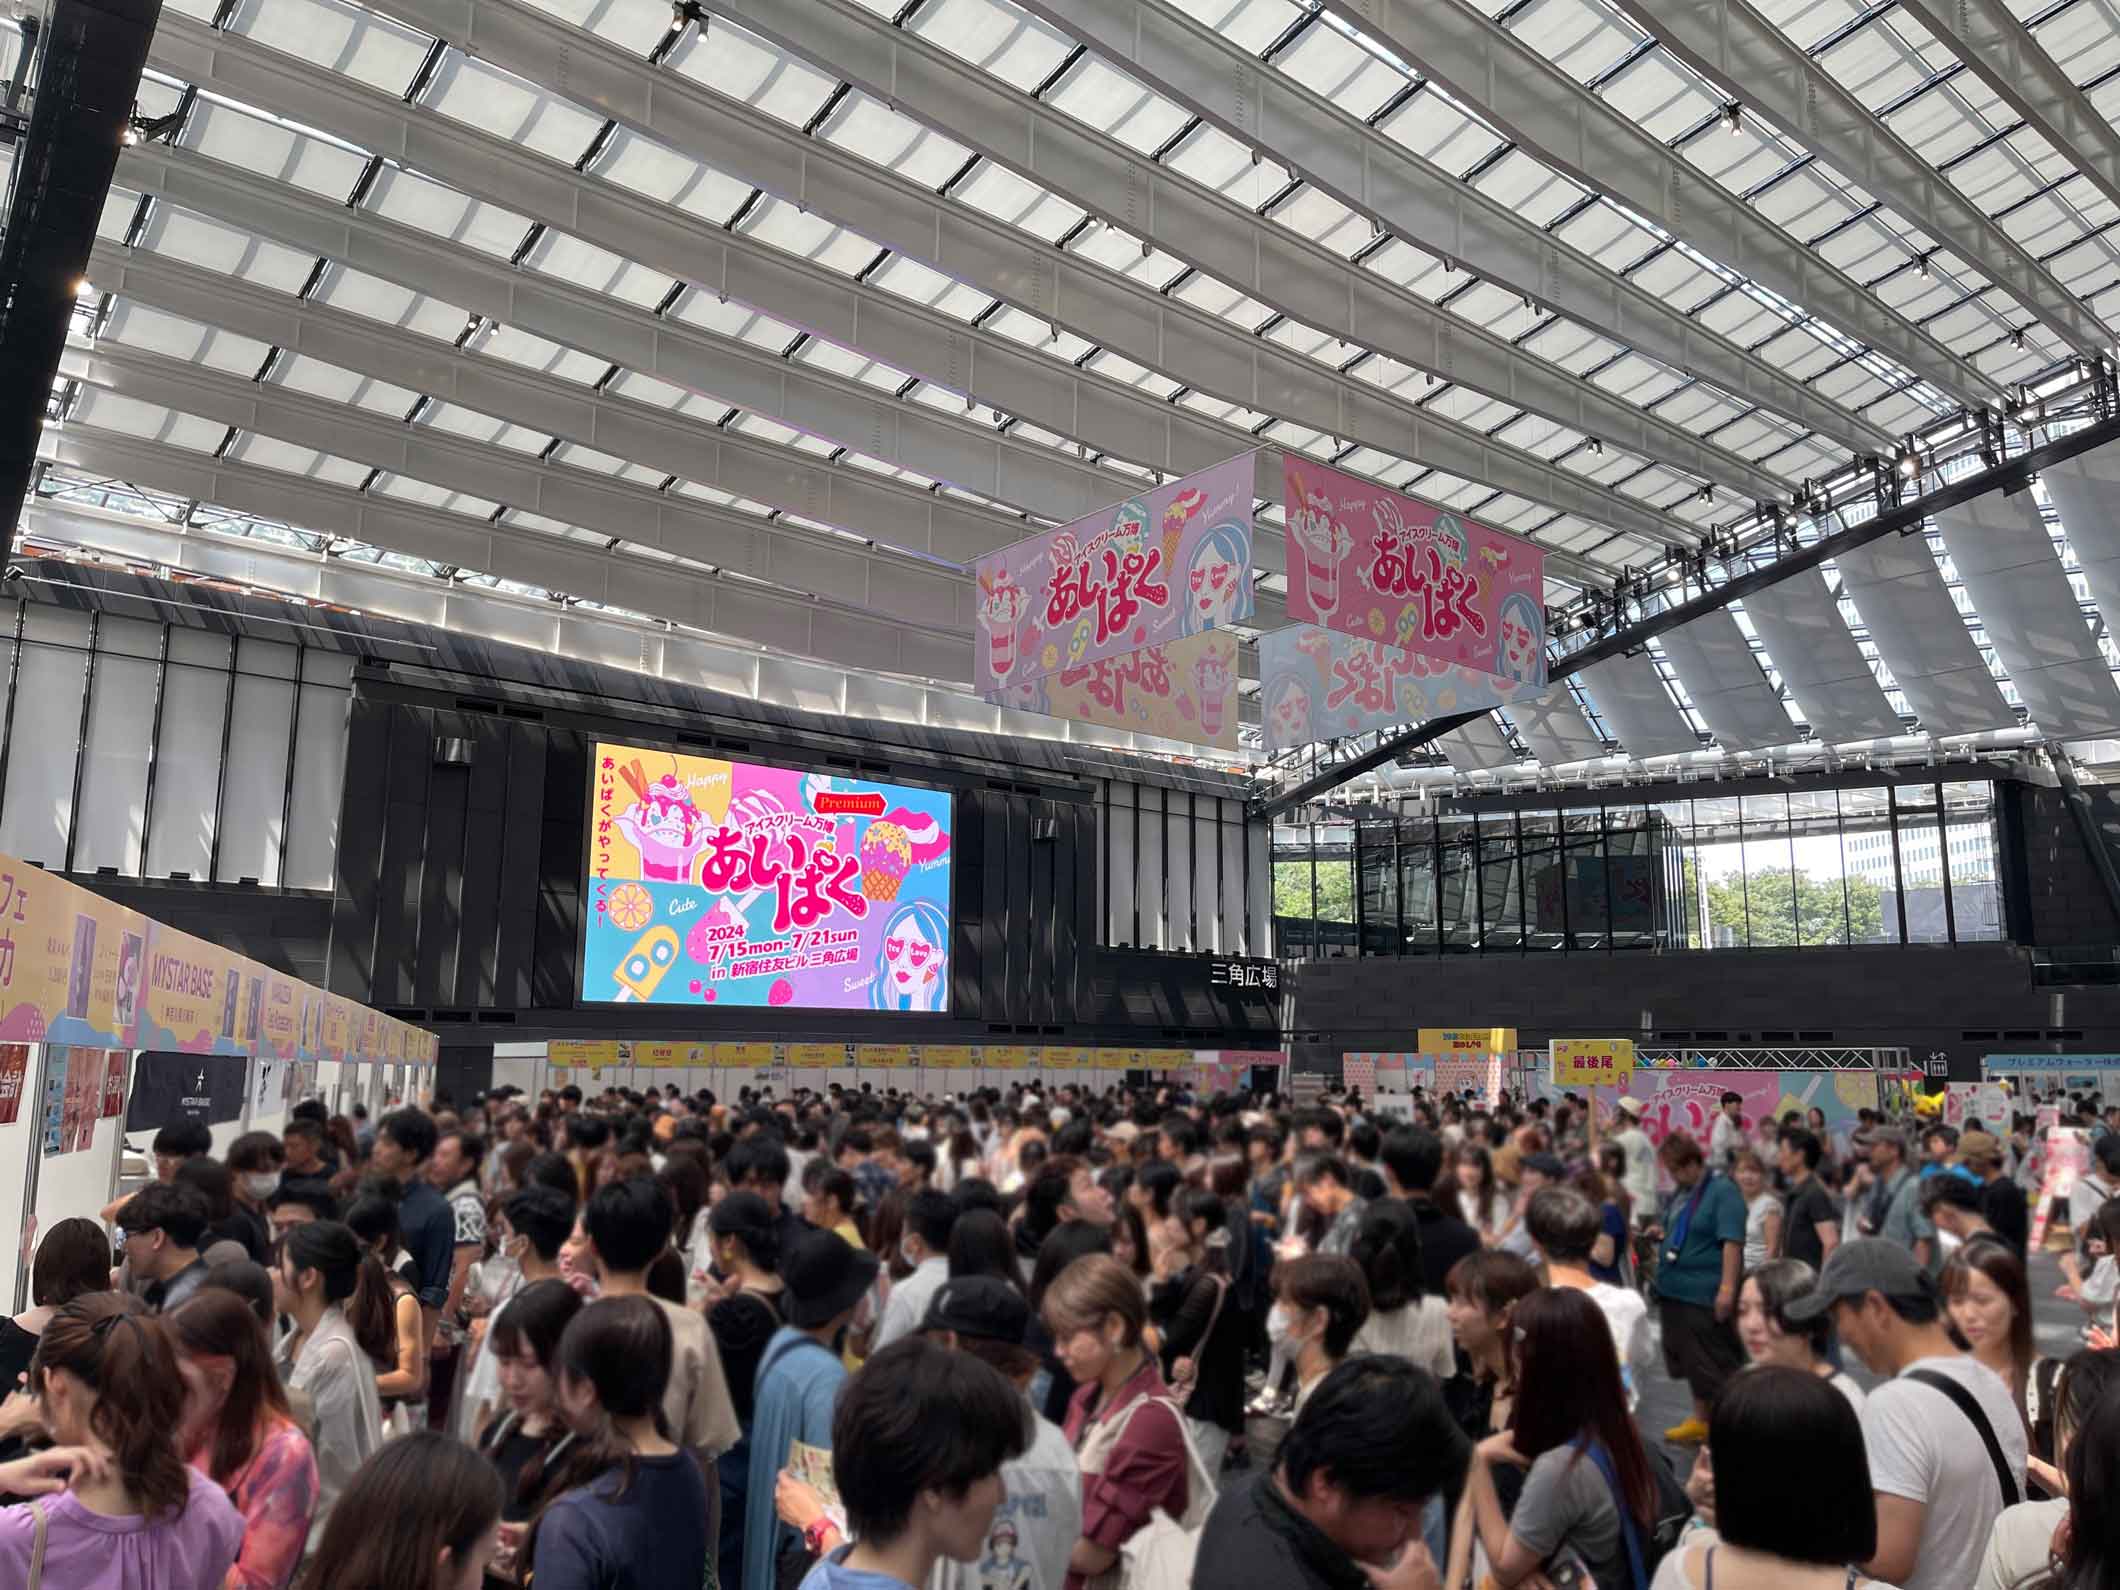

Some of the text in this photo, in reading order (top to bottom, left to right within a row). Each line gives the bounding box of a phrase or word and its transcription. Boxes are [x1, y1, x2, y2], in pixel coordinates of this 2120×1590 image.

[1049, 549, 1168, 645] あいぱく
[1373, 532, 1485, 637] あいぱく
[820, 796, 881, 810] Premium
[744, 814, 836, 835] アイスクリーム万博
[701, 826, 869, 932] あいぱく
[669, 899, 697, 915] Cute
[708, 925, 745, 942] 2024
[151, 951, 214, 999] MYSTAR BASE
[711, 947, 858, 979] in 新宿住友ビル 三角広場
[1210, 963, 1277, 988] 三角広場
[1573, 1055, 1613, 1069] 最後尾
